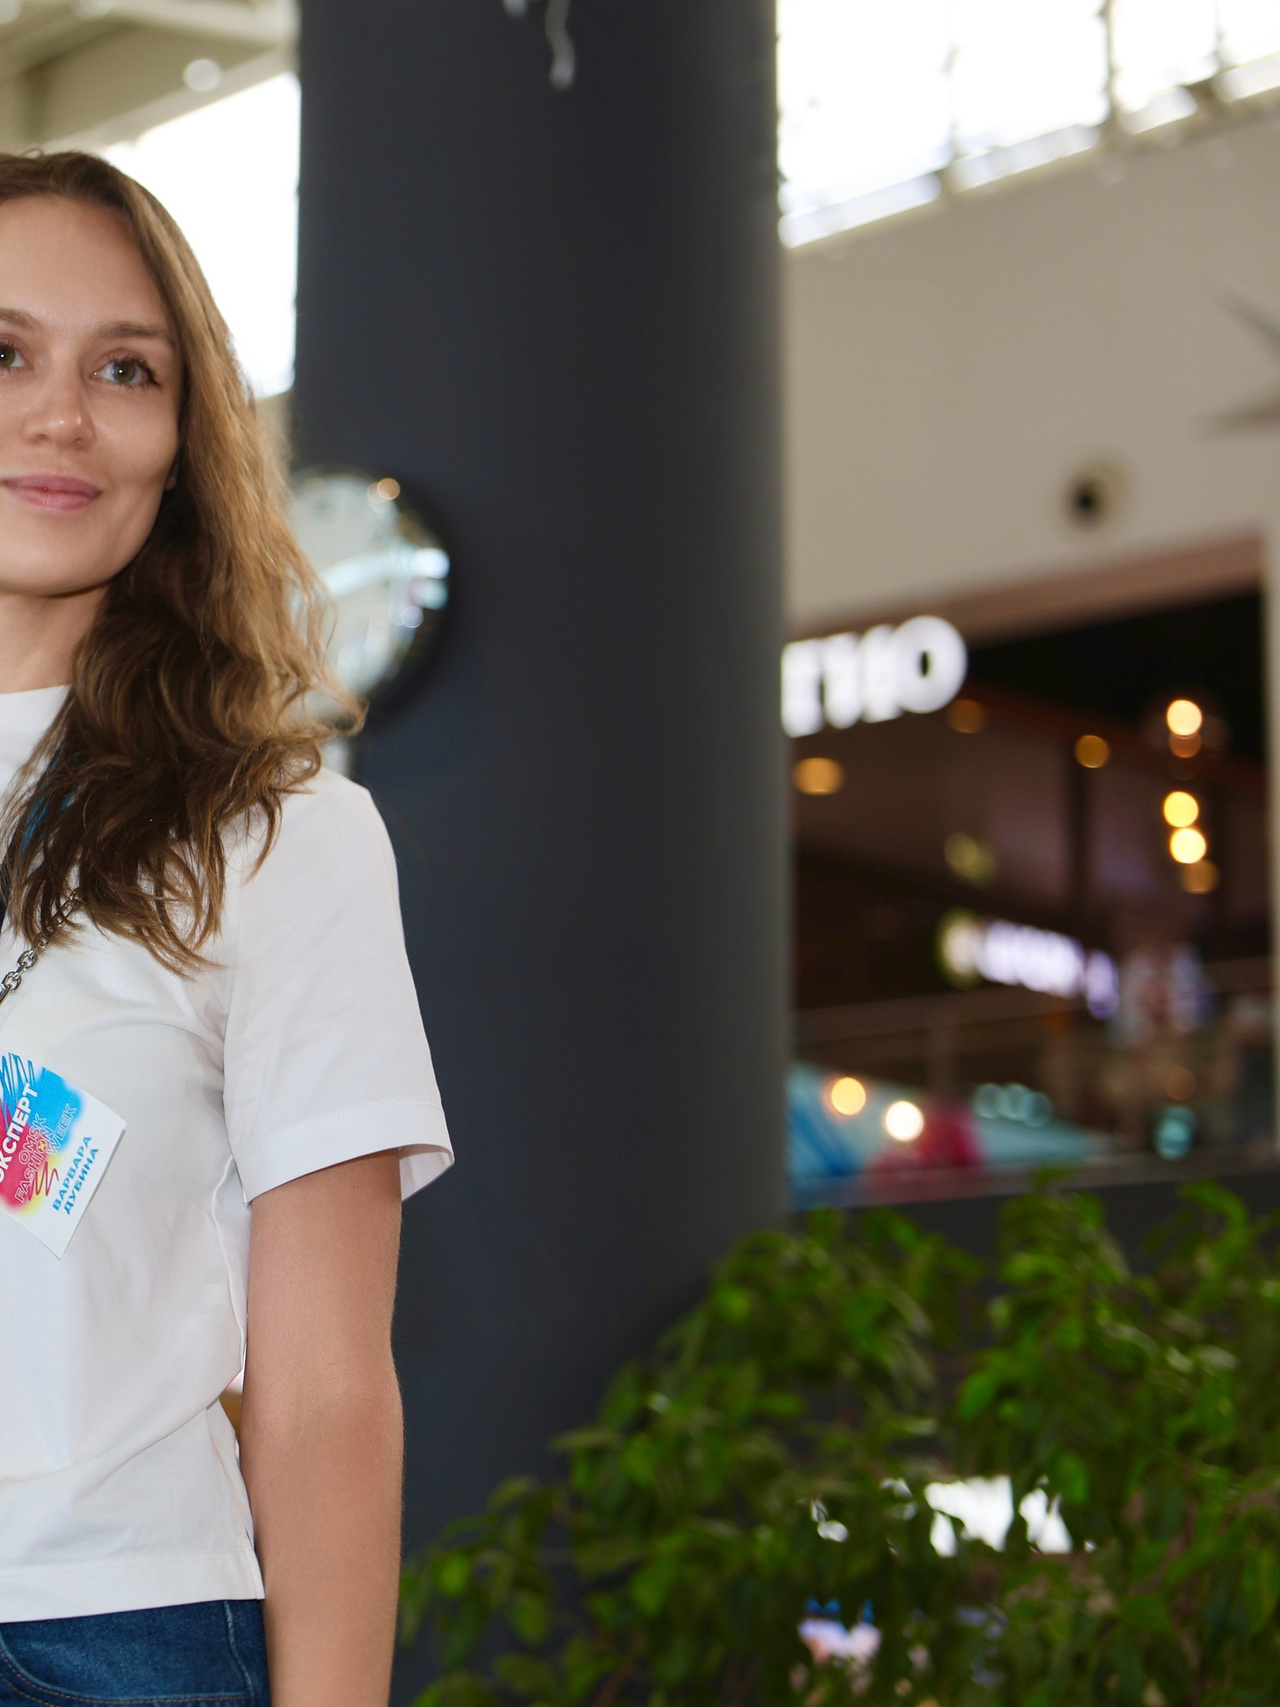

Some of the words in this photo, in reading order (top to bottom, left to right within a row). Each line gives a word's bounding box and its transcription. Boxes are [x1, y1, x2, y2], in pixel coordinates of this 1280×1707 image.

[19, 1113, 46, 1165] OMSK
[45, 1102, 77, 1156] WEEK
[14, 1125, 53, 1204] FASHION
[52, 1136, 92, 1211] ВАРВАРА
[63, 1148, 99, 1215] ДУБИНА
